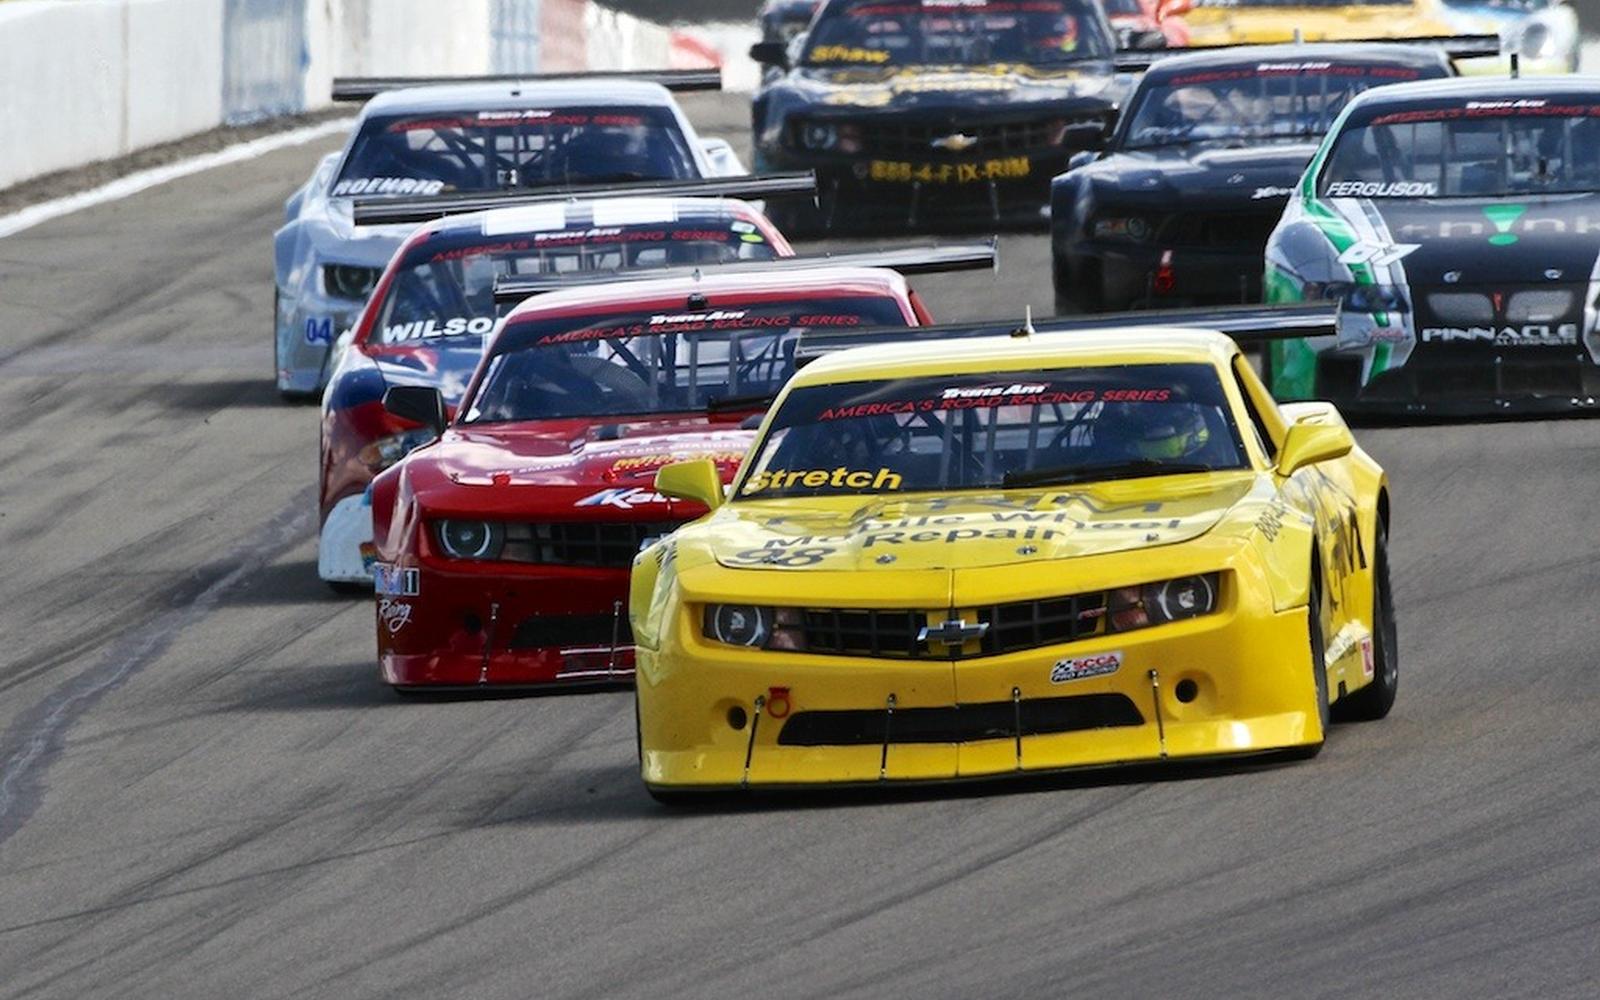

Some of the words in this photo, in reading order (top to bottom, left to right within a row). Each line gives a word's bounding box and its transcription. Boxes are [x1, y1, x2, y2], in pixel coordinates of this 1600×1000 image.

[1325, 181, 1438, 197] FERGUSON
[534, 231, 584, 242] Trans
[585, 228, 622, 238] Am
[431, 240, 530, 262] AMERICA'S
[671, 230, 729, 241] SERIES
[650, 314, 706, 325] Trans
[708, 311, 746, 321] Am
[306, 318, 331, 344] 04
[537, 325, 642, 346] AMERICA'S
[712, 315, 792, 329] RACING
[796, 314, 861, 326] SERIES
[1422, 324, 1577, 342] PINNACLE
[942, 387, 1003, 399] Trans
[1005, 384, 1046, 395] Am
[818, 401, 933, 421] AMERICA'S
[941, 397, 1002, 410] ROAD
[1010, 391, 1096, 406] RACING
[1099, 389, 1172, 402] SERIES
[862, 525, 1066, 548] Repair
[1073, 656, 1118, 671] SCCA
